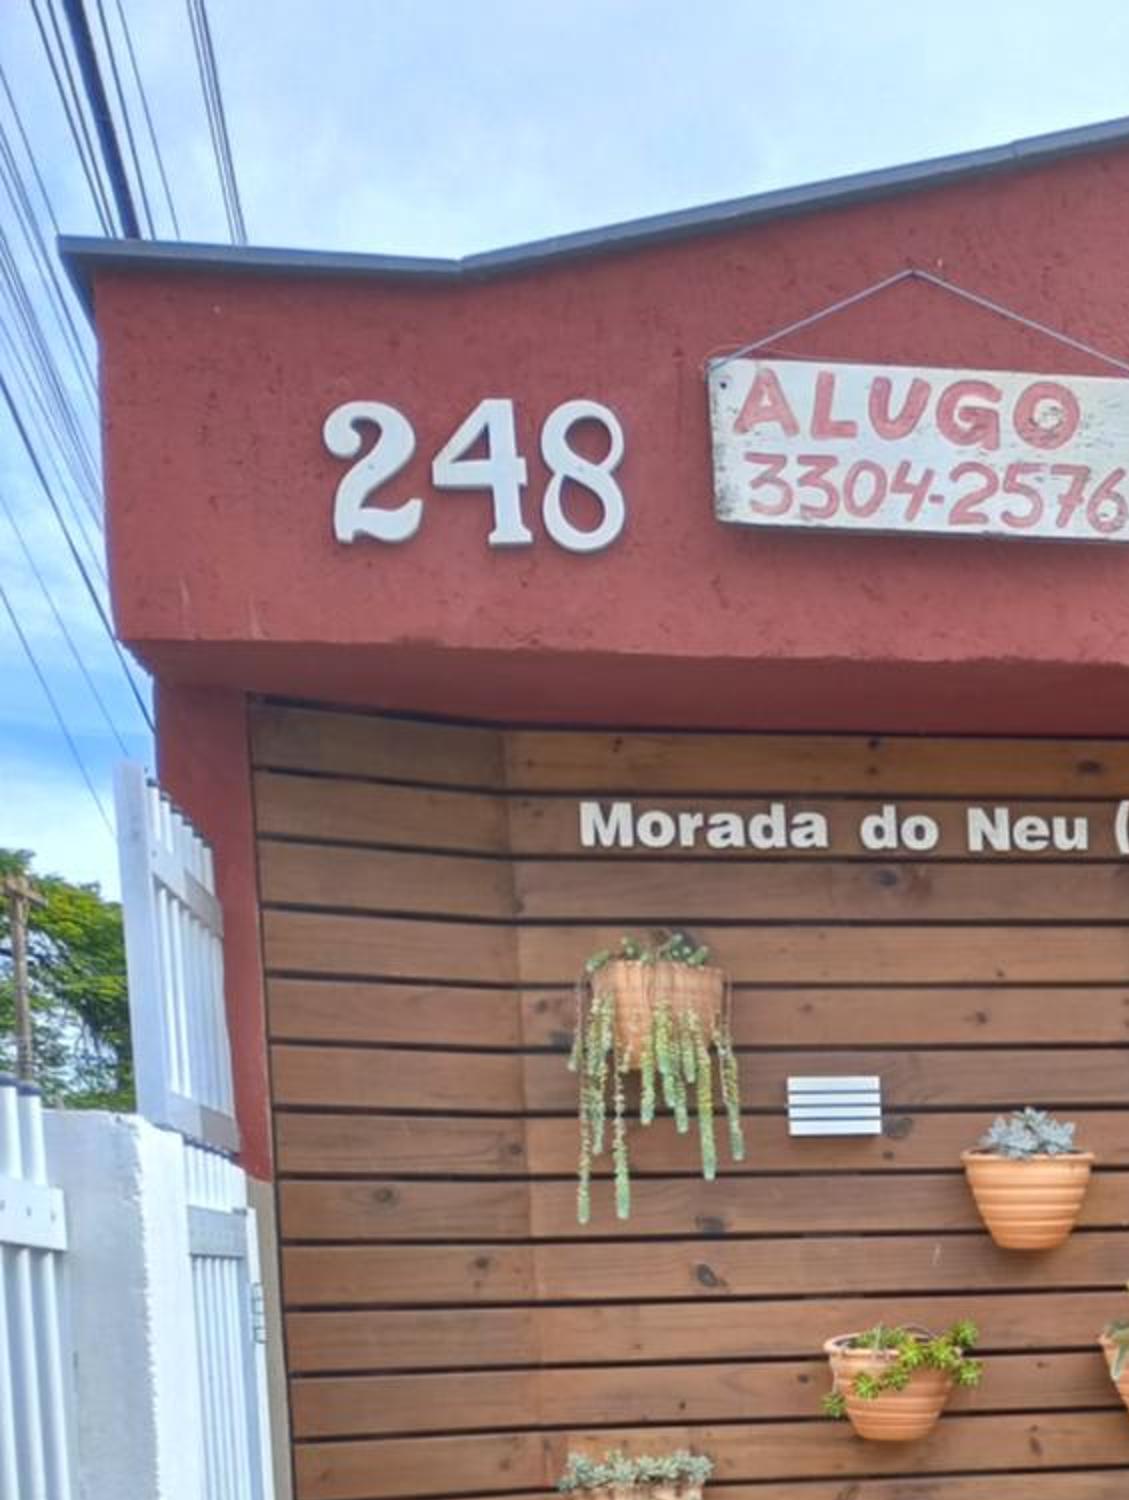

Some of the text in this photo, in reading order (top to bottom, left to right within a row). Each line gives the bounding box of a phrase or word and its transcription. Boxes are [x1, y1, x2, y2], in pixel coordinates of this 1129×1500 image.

[733, 368, 1081, 451] ALUGO
[323, 398, 627, 553] 248
[744, 451, 1129, 533] 3304-2576
[579, 801, 829, 850] Morada
[859, 805, 939, 851] do
[967, 806, 1088, 852] Neu
